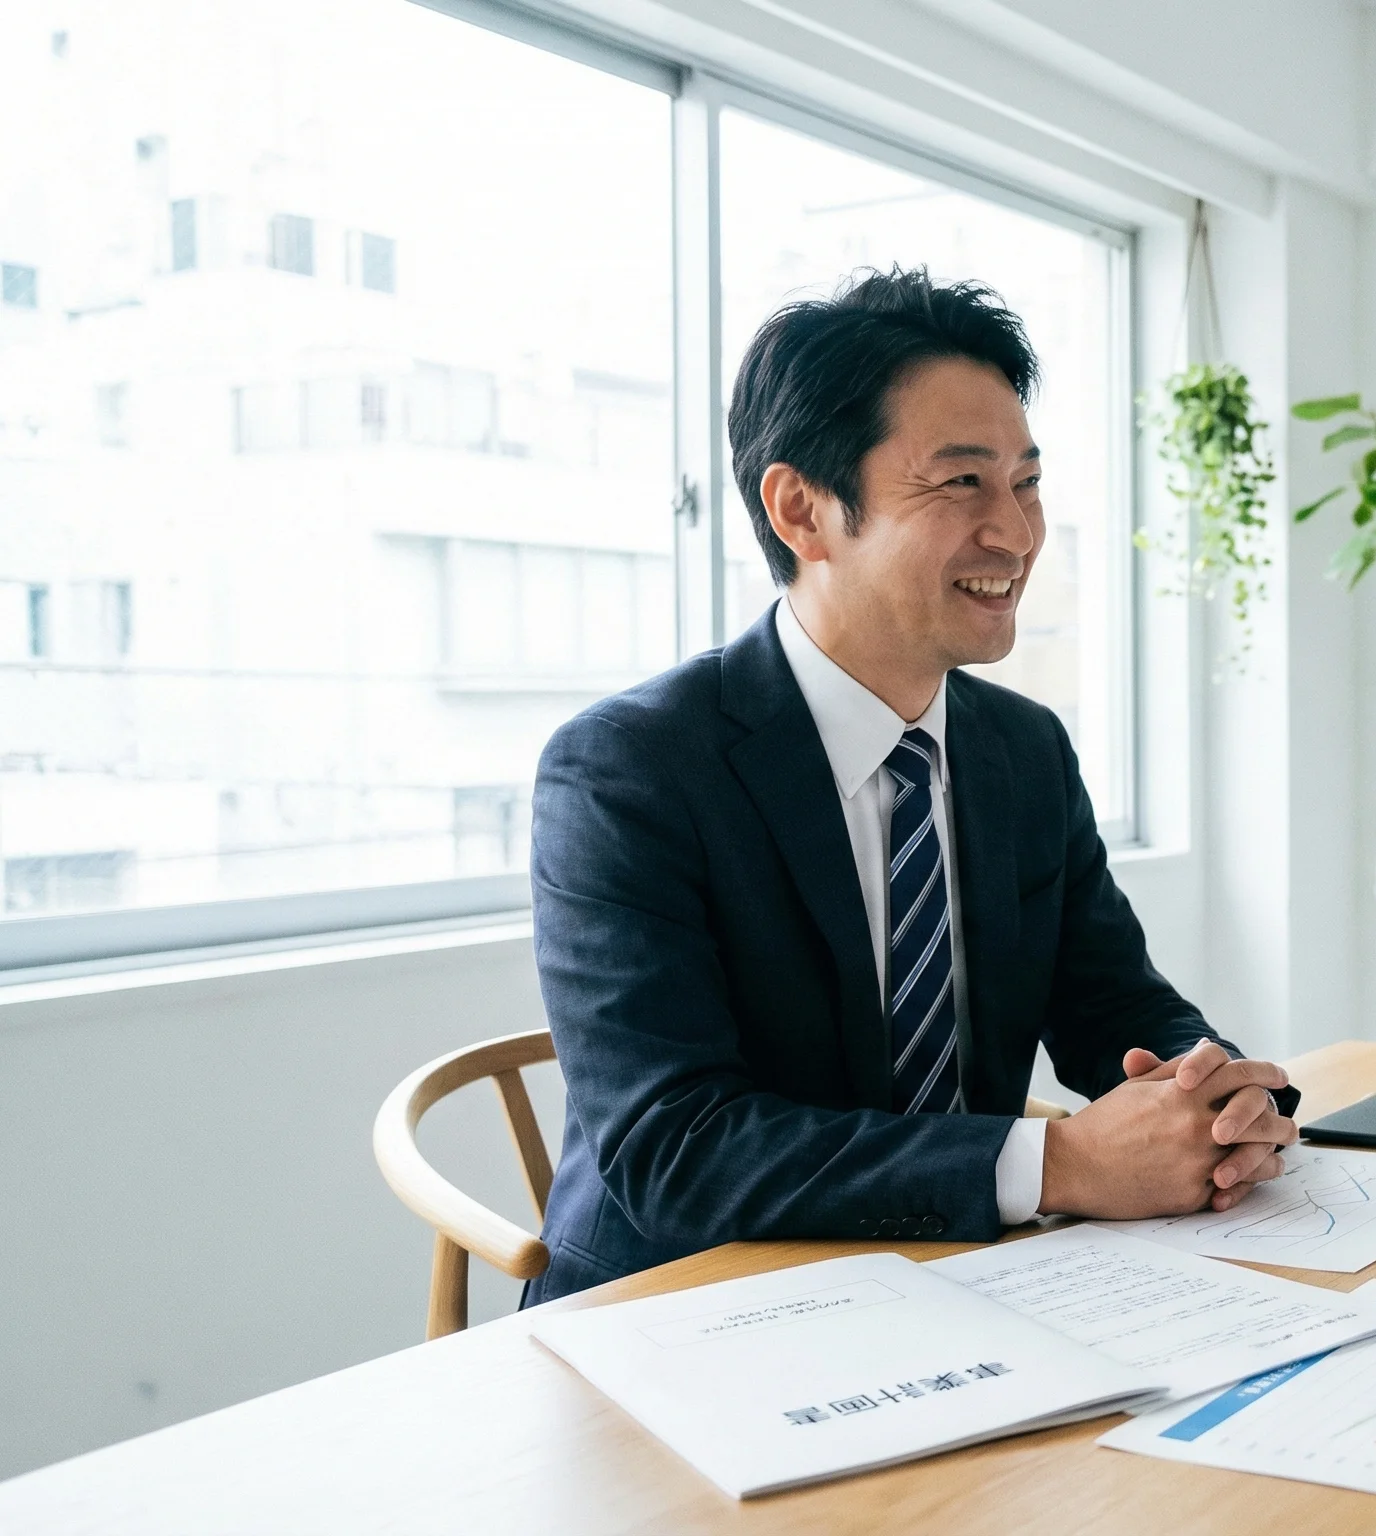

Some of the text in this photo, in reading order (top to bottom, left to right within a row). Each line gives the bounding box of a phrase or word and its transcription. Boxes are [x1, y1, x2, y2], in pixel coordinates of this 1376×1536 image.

[783, 1362, 1013, 1426] 事業計画書
